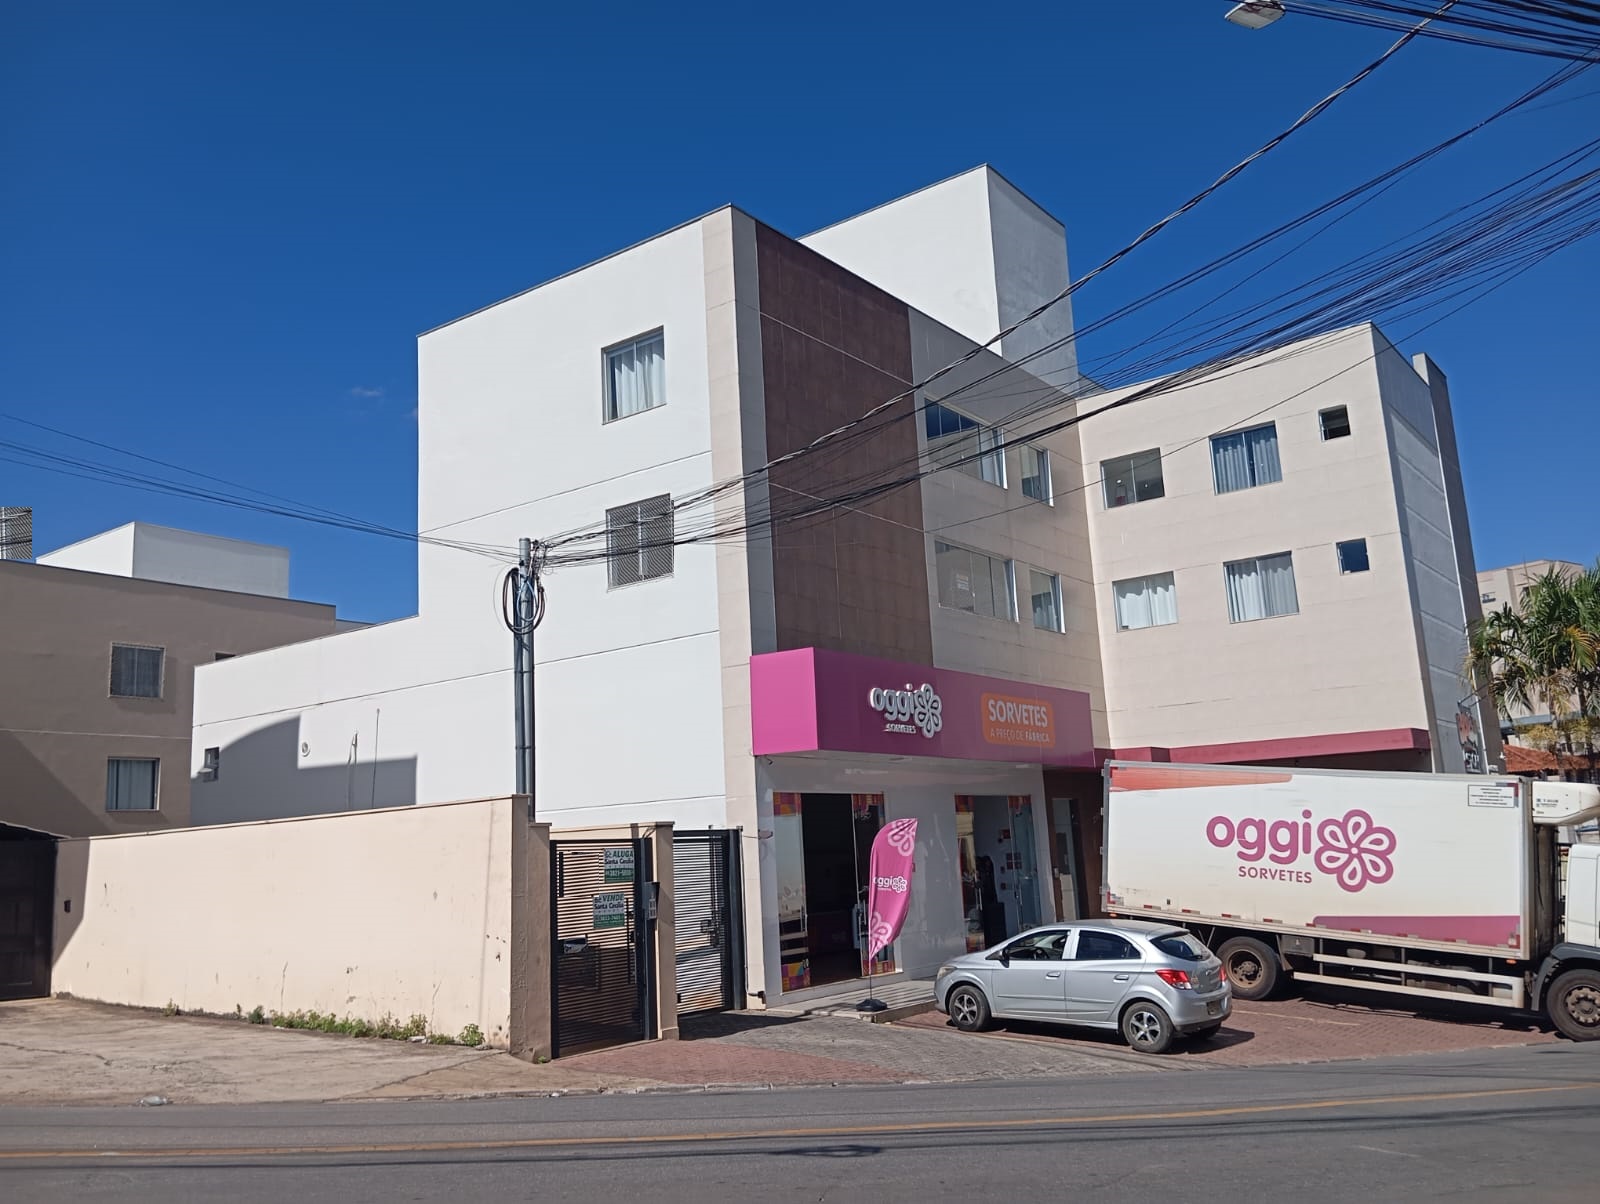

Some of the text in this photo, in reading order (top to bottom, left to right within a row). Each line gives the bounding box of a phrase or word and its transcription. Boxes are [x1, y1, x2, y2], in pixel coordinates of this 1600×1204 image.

[870, 683, 914, 721] oggi
[988, 699, 1048, 728] SORVETES
[1206, 809, 1312, 865] oggi
[1238, 866, 1313, 884] SORVETES
